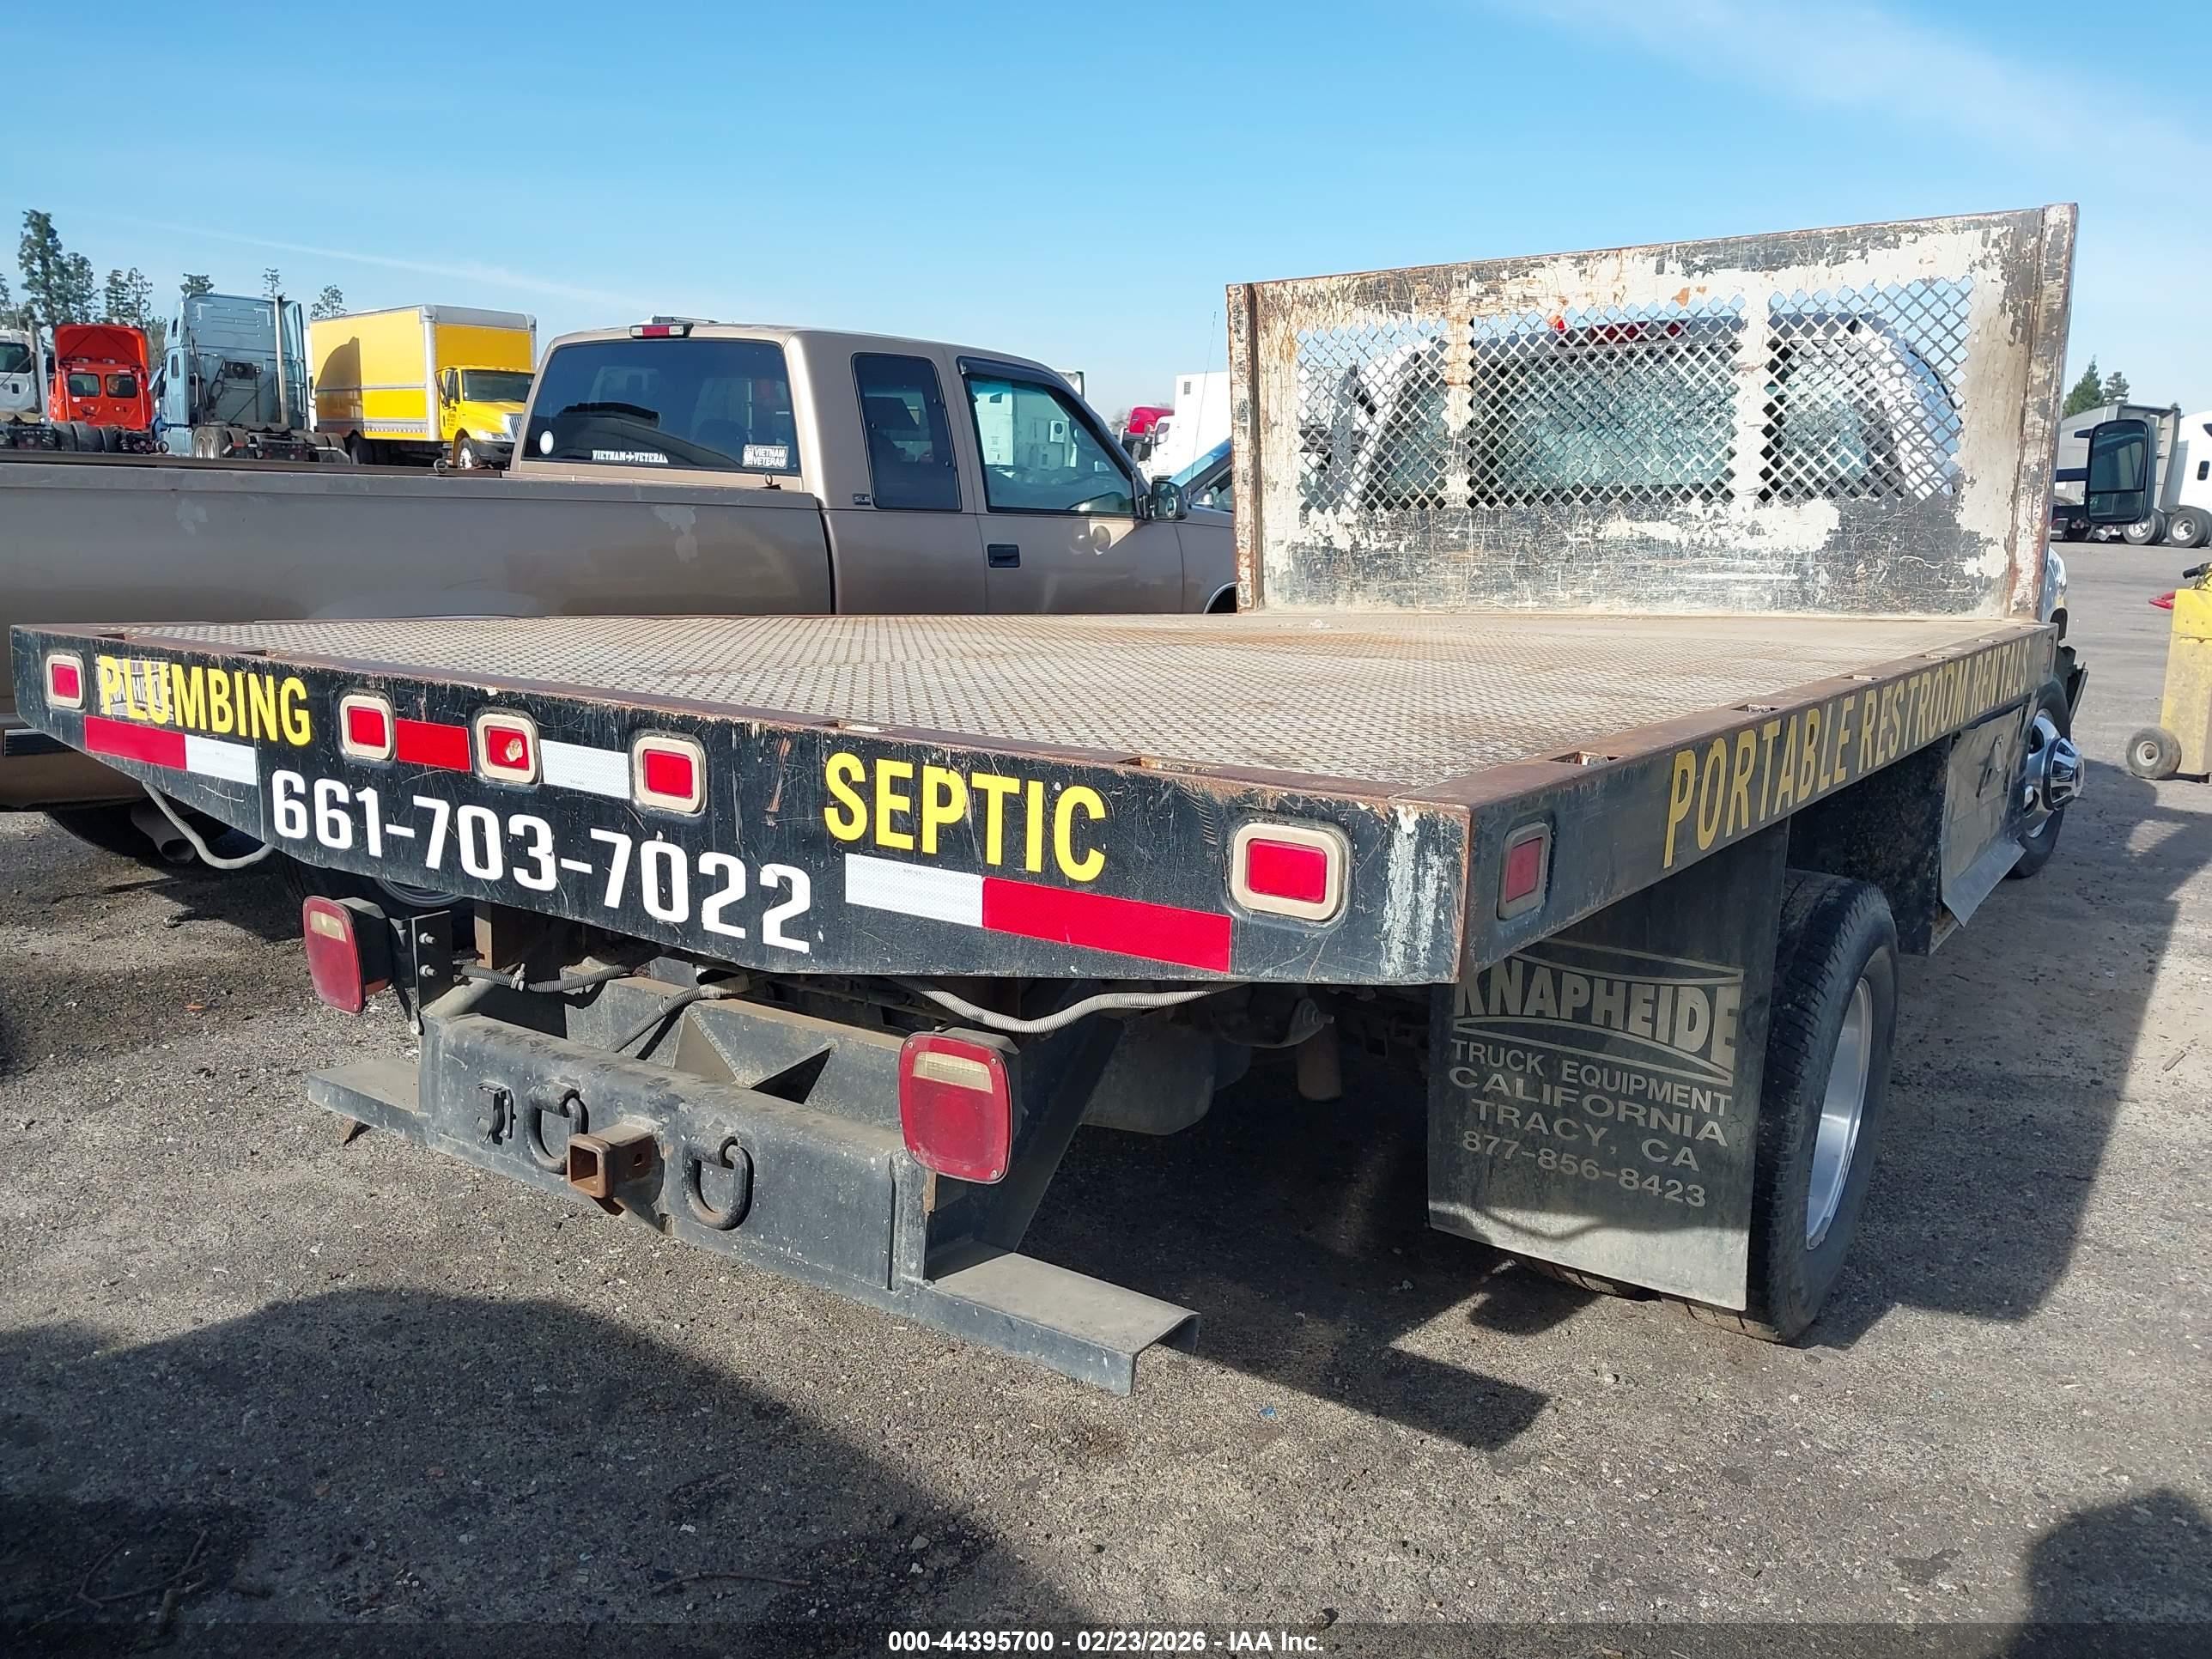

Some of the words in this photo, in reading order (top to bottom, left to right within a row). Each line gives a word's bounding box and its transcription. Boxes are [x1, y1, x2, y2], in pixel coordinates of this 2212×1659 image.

[592, 450, 626, 461] VIETNAM
[753, 456, 786, 467] VETERAN
[755, 447, 786, 458] VIETNAM
[99, 654, 312, 746] PLUMBING
[1663, 694, 1855, 869] PORTABLE
[1857, 658, 1971, 775] RESTROOM
[1969, 637, 2030, 719] RENTALS
[823, 752, 1106, 882] SEPTIC
[272, 769, 811, 954] 661-703-7022
[1449, 1066, 1729, 1147] CALIFORNIA
[1450, 1038, 1545, 1077] TRUCK
[1561, 1060, 1733, 1117] EQUIPMENT
[1462, 1130, 1708, 1208] 877-856-8423
[1472, 1098, 1617, 1154] TRACY,
[1641, 1138, 1700, 1172] CA
